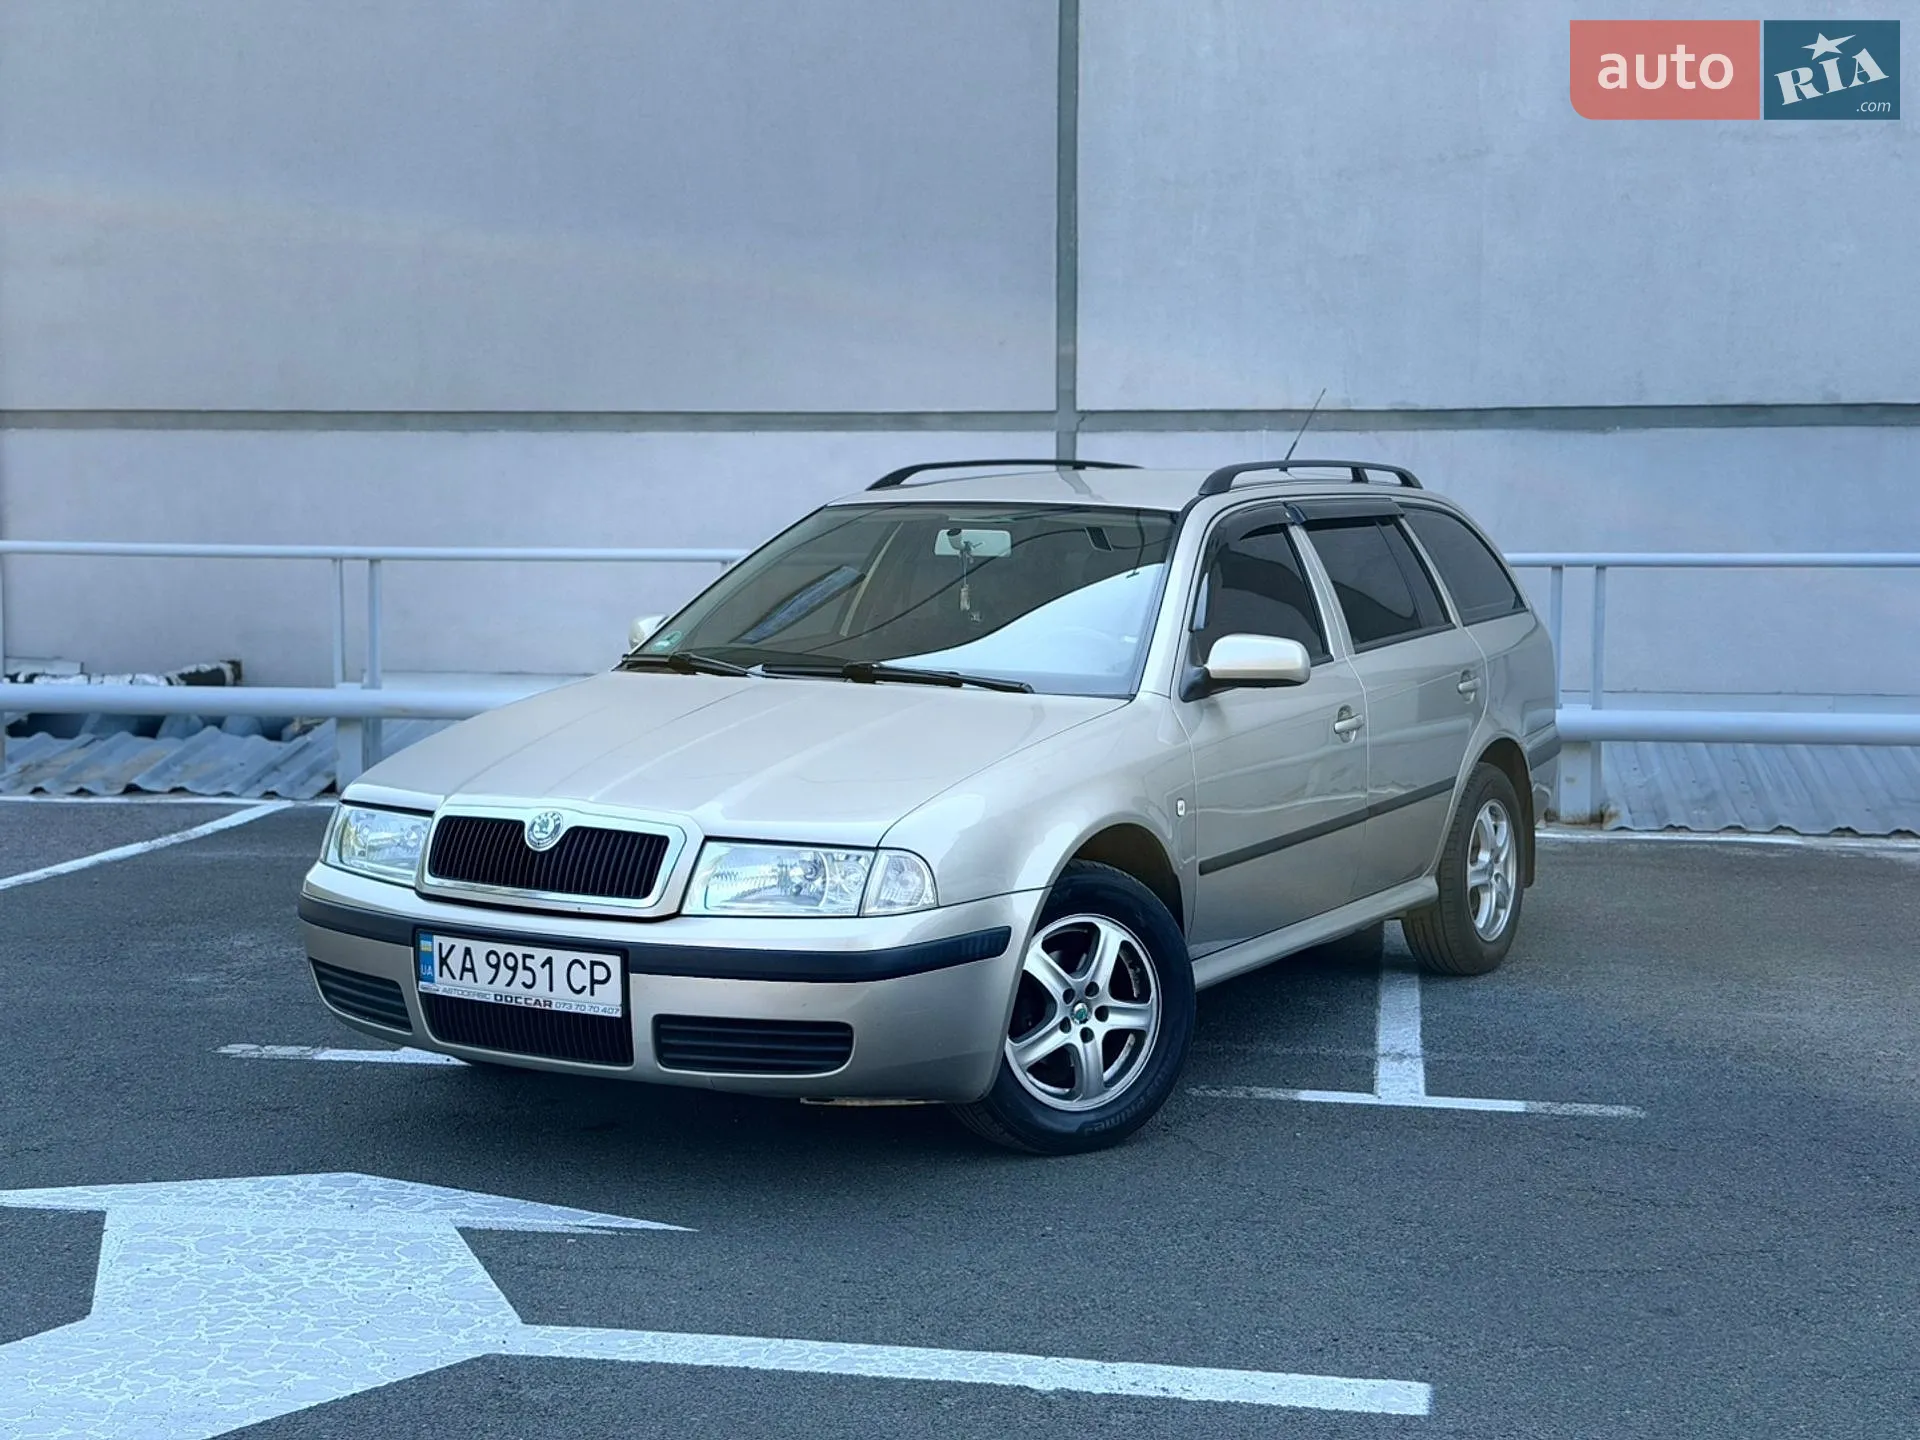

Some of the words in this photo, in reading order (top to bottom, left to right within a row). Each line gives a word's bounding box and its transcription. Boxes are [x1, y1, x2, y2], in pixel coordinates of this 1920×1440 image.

[421, 964, 434, 977] UA
[438, 942, 478, 983] KA
[485, 949, 553, 992] 9951
[566, 959, 611, 997] CP
[555, 1001, 573, 1010] 073
[575, 1003, 586, 1012] 70
[588, 1005, 600, 1013] 70
